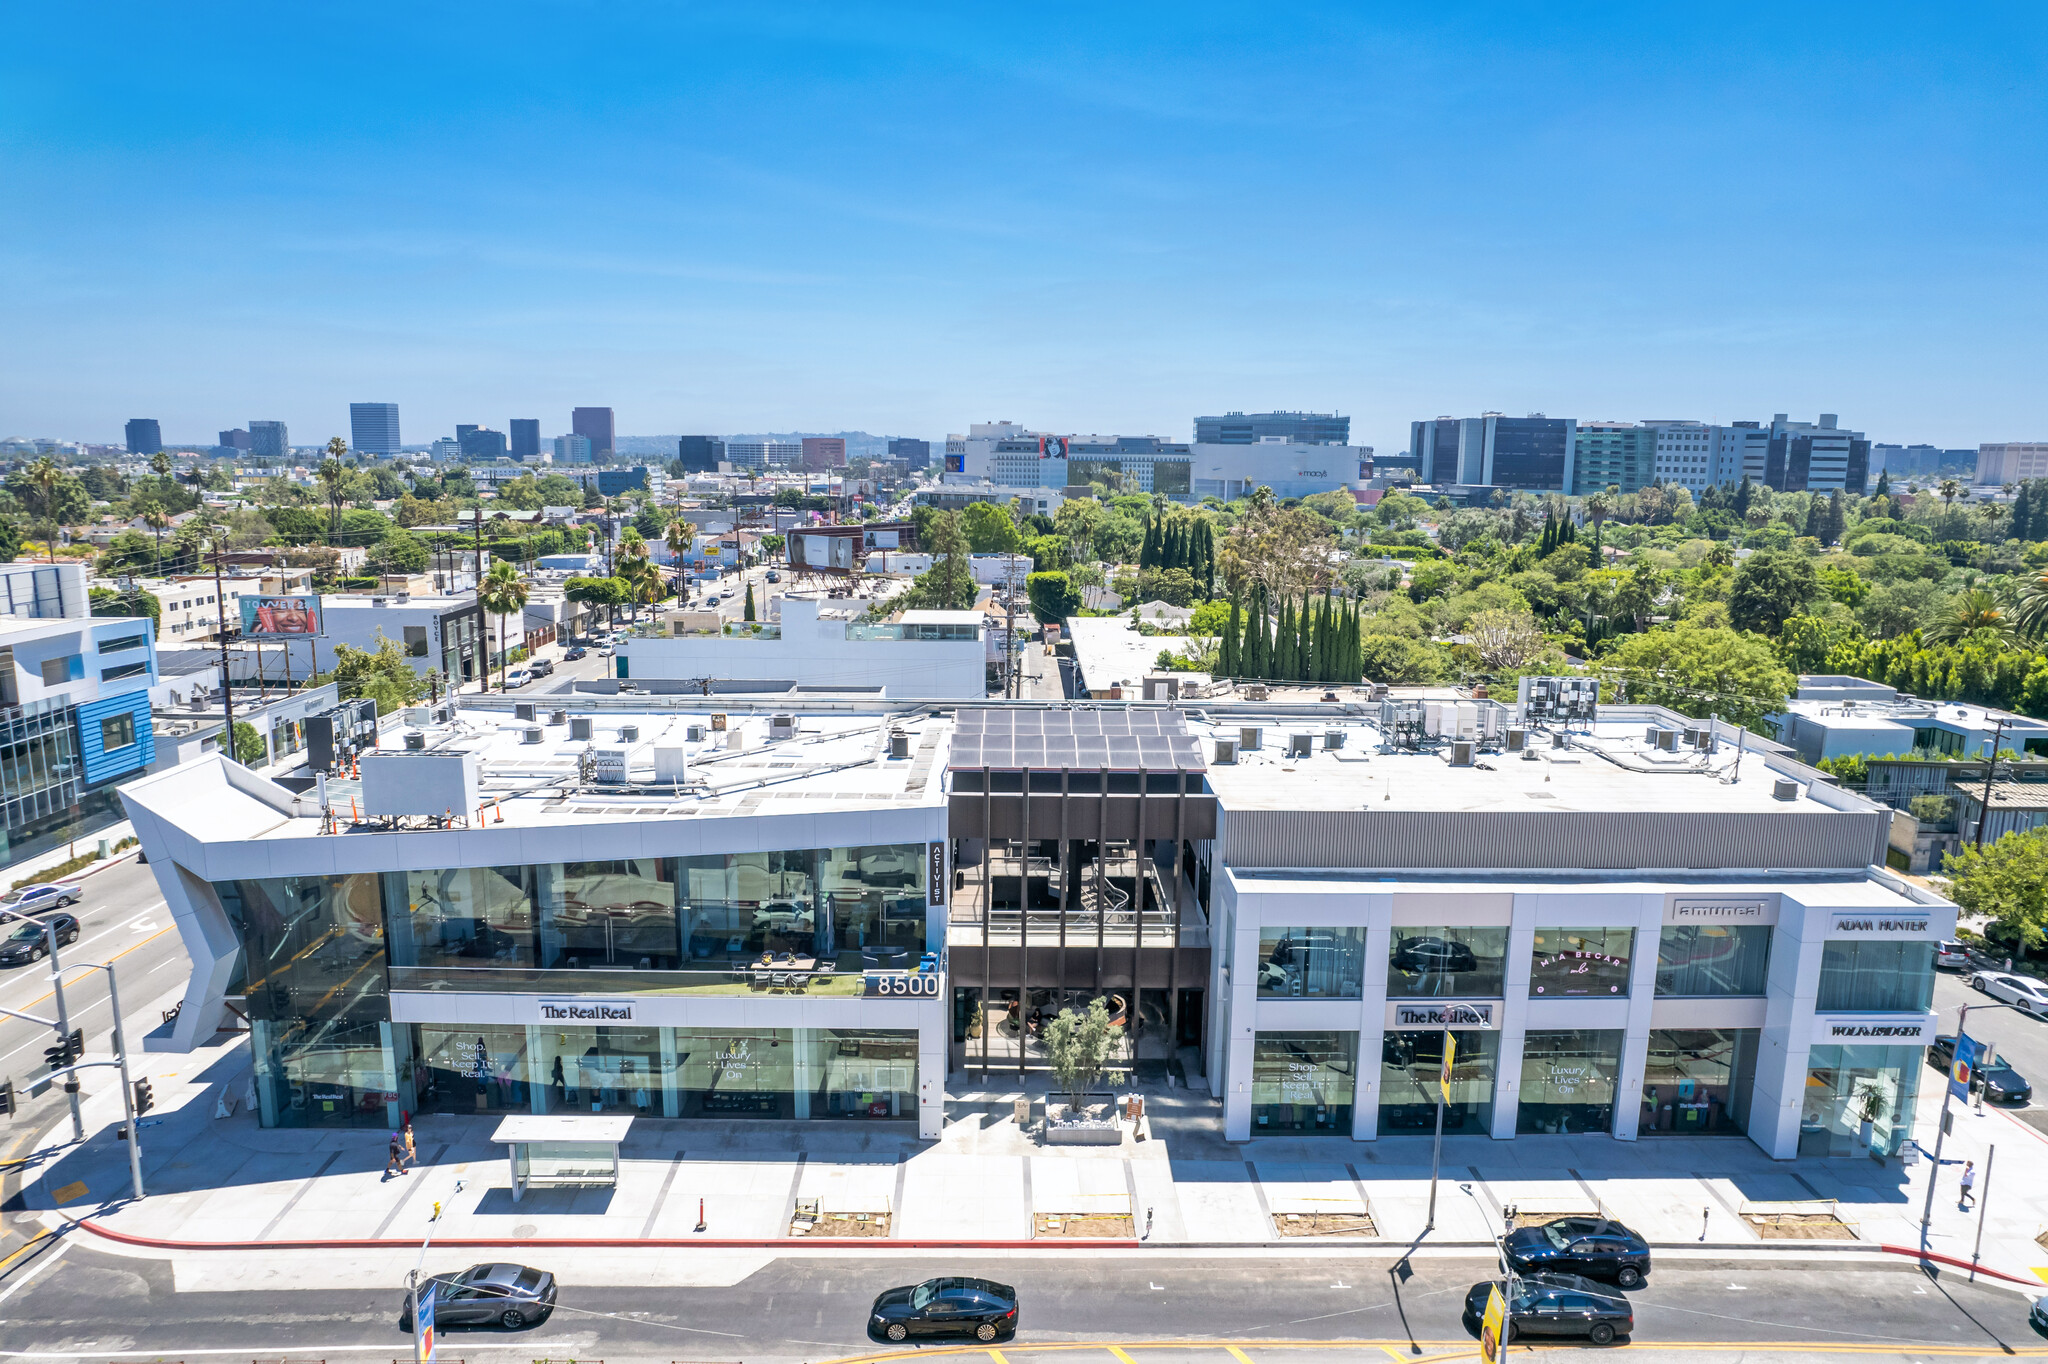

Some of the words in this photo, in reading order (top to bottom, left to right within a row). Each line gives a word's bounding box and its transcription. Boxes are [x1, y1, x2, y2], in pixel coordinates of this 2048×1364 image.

[245, 600, 295, 609] TOWER
[933, 846, 941, 902] ACTIVIST
[1679, 904, 1761, 915] amuneal
[1836, 920, 1874, 931] ADAM
[1878, 920, 1928, 931] HUNTER
[1540, 953, 1566, 968] MIA
[1575, 951, 1620, 967] BECAR
[878, 976, 938, 995] 8500
[456, 1041, 486, 1051] Shop.
[715, 1050, 751, 1061] Luxury
[452, 1060, 479, 1070] Keep
[720, 1060, 747, 1069] Lives
[1289, 1062, 1319, 1072] Shop.
[726, 1070, 743, 1079] On
[1551, 1065, 1586, 1076] Luxury
[1554, 1075, 1580, 1085] Lives
[1282, 1081, 1310, 1091] Keep
[1558, 1085, 1575, 1094] On
